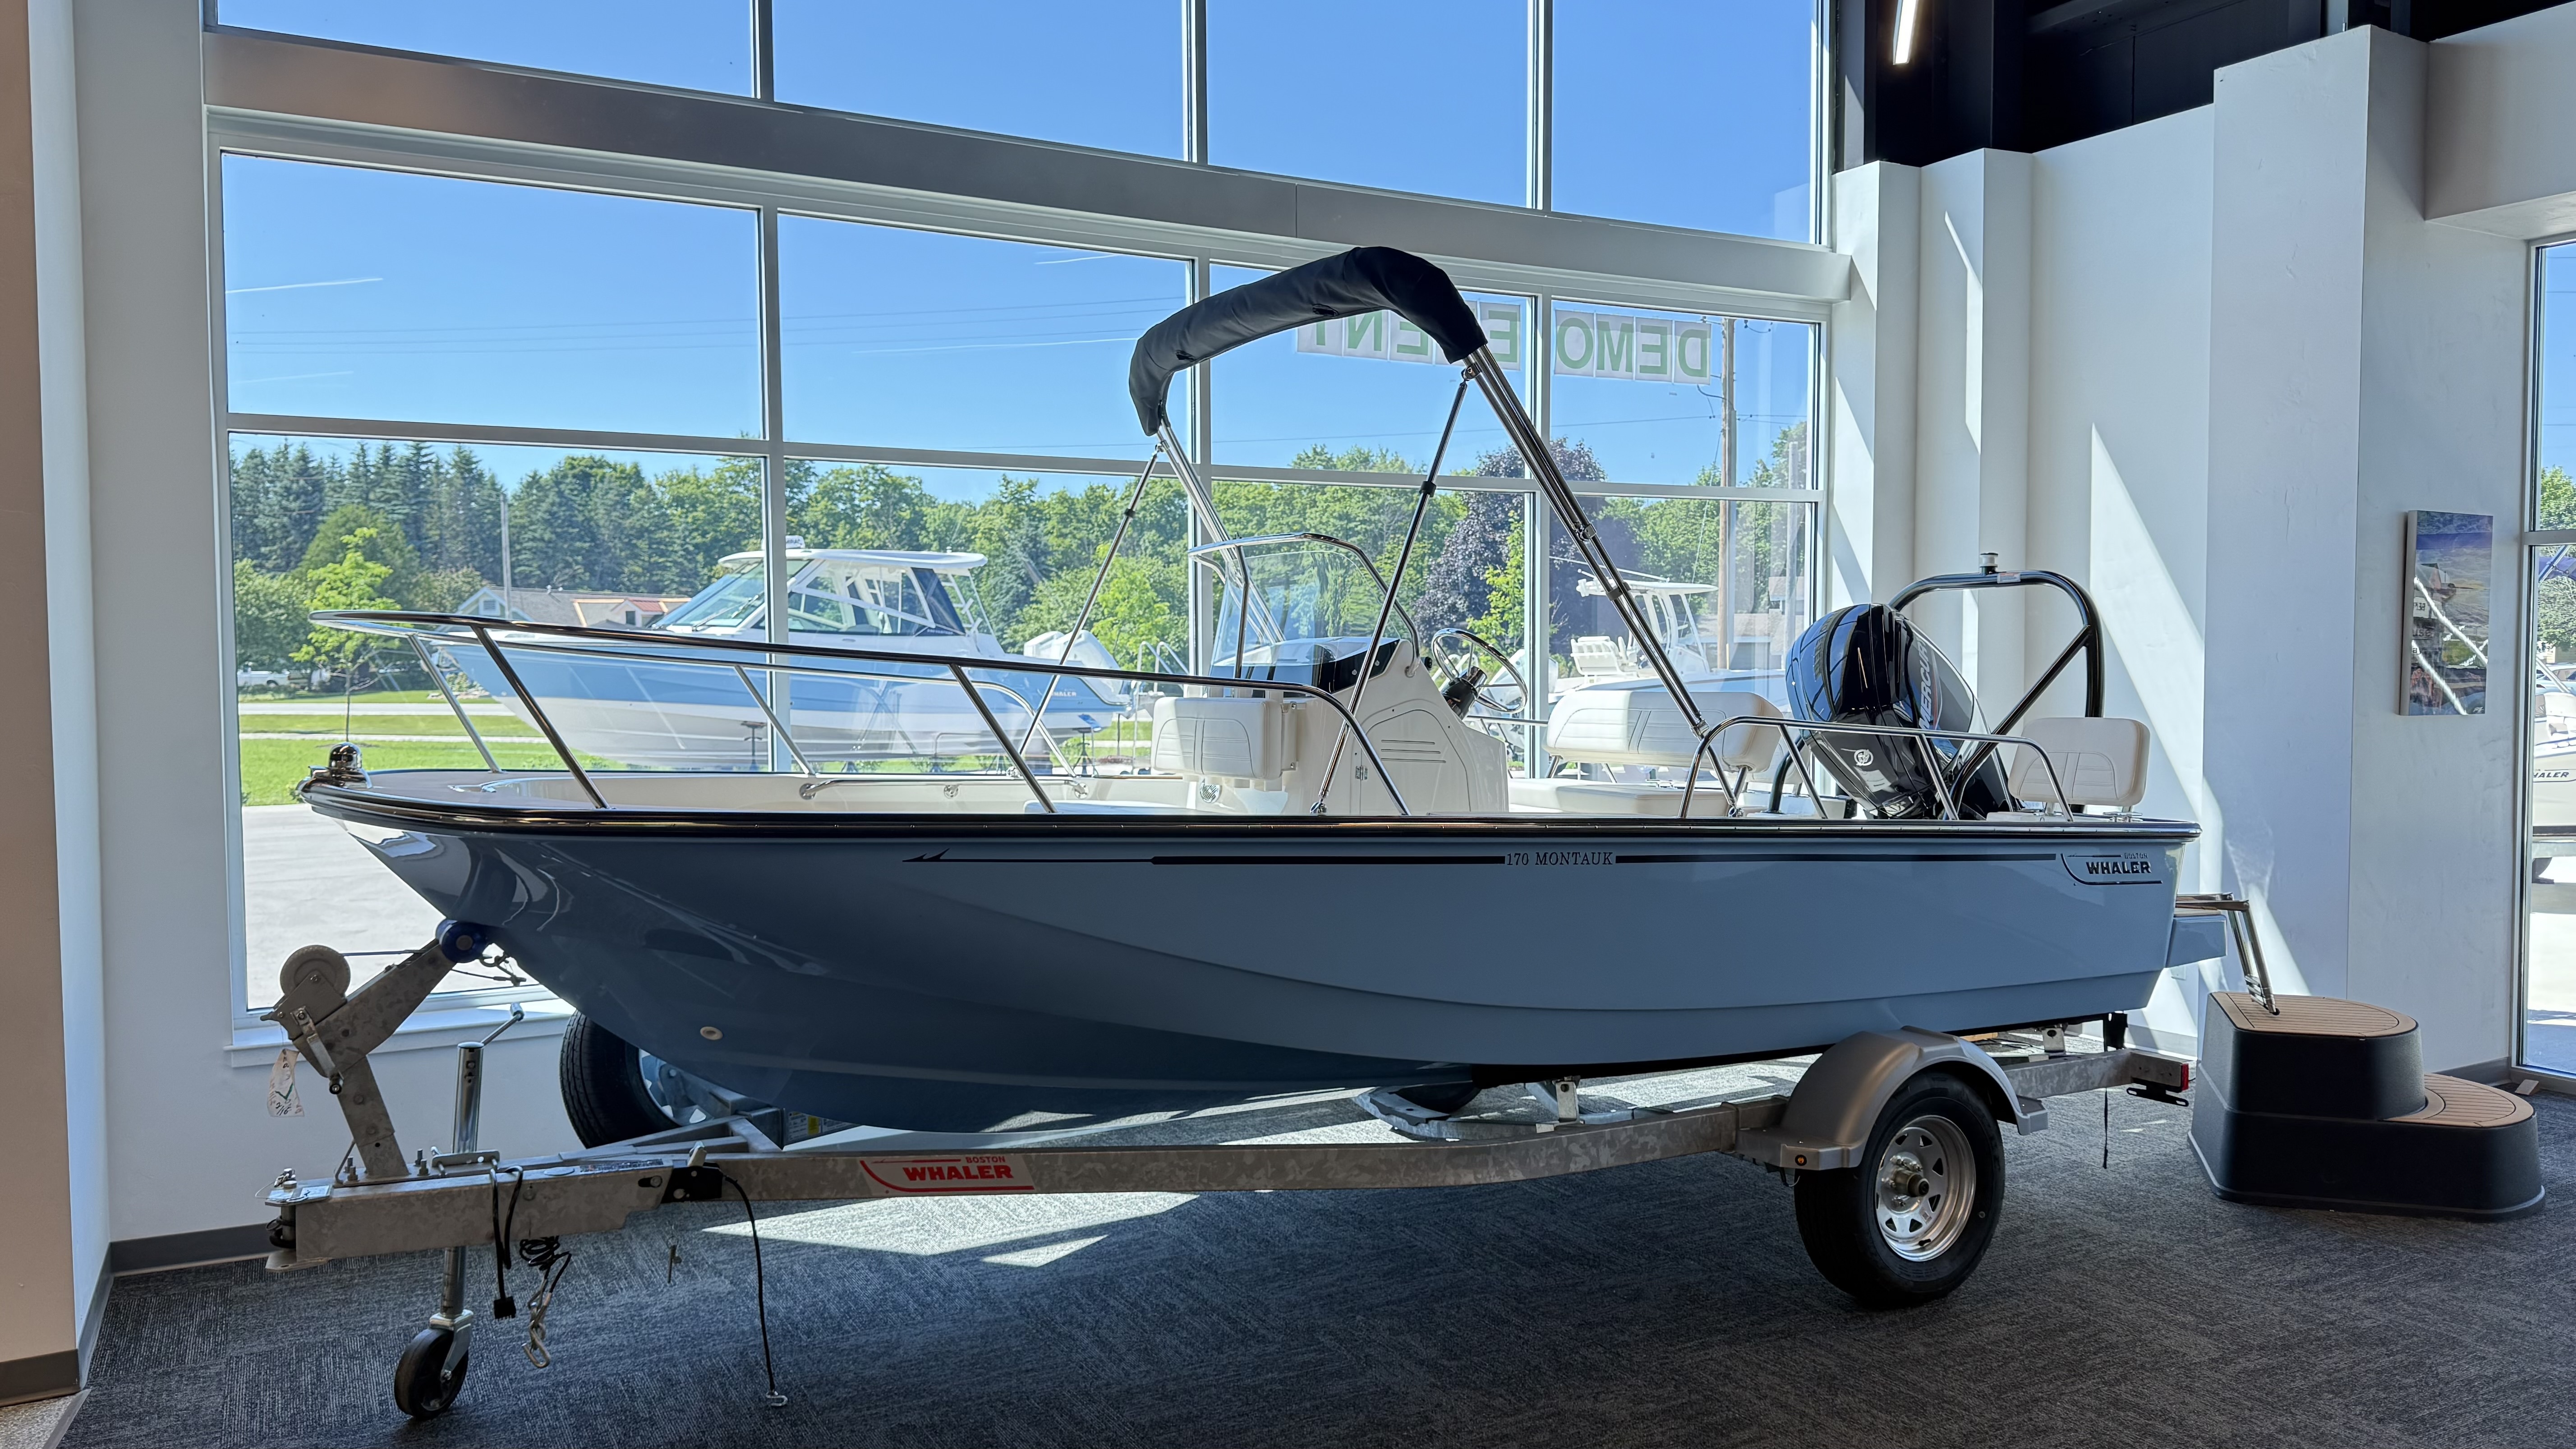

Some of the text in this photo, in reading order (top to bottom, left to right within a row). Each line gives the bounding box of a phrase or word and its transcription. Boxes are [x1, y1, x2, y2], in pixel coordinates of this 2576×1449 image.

[1507, 852, 1613, 865] 170 MONTAUK
[2086, 861, 2151, 874] WHALER
[902, 1165, 1014, 1181] WHALER
